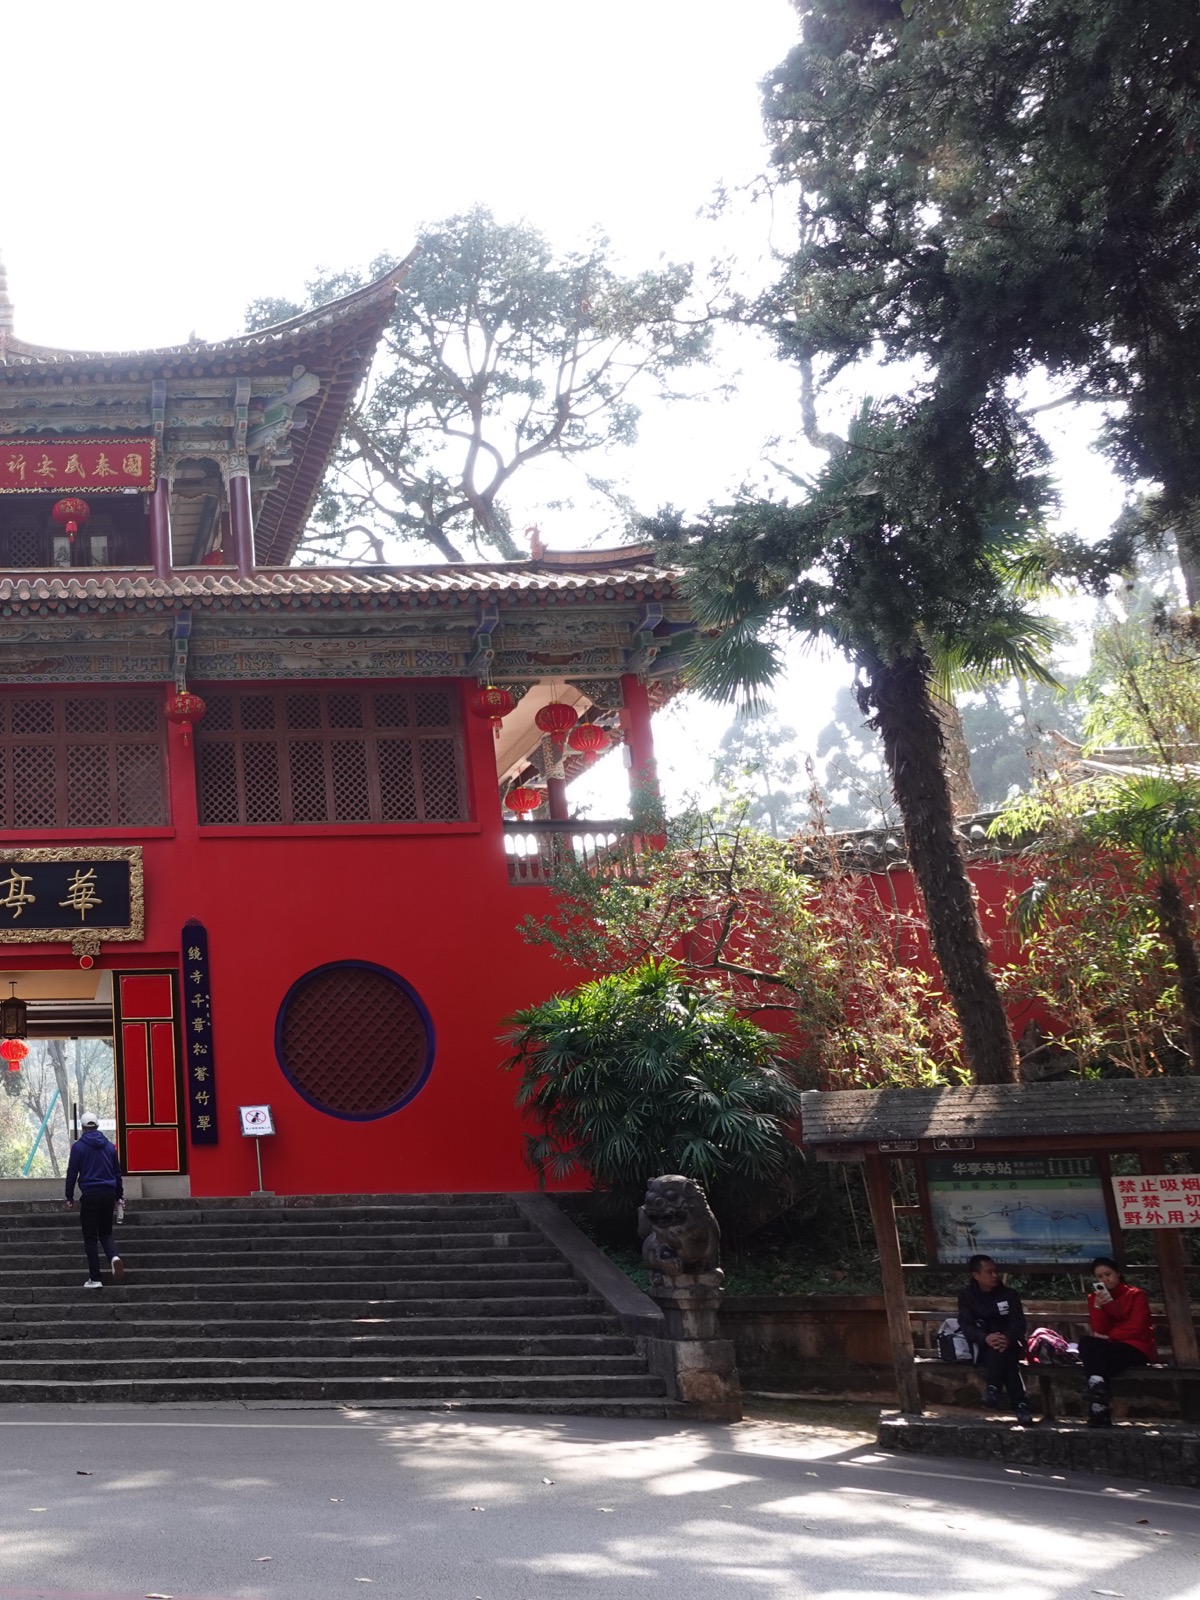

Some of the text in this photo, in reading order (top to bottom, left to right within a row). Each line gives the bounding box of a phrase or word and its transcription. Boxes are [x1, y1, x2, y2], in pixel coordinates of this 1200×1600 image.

[952, 1161, 1013, 1176] 华亭寺站
[1117, 1178, 1200, 1194] 禁止吸烟
[1121, 1193, 1200, 1210] 严禁一切
